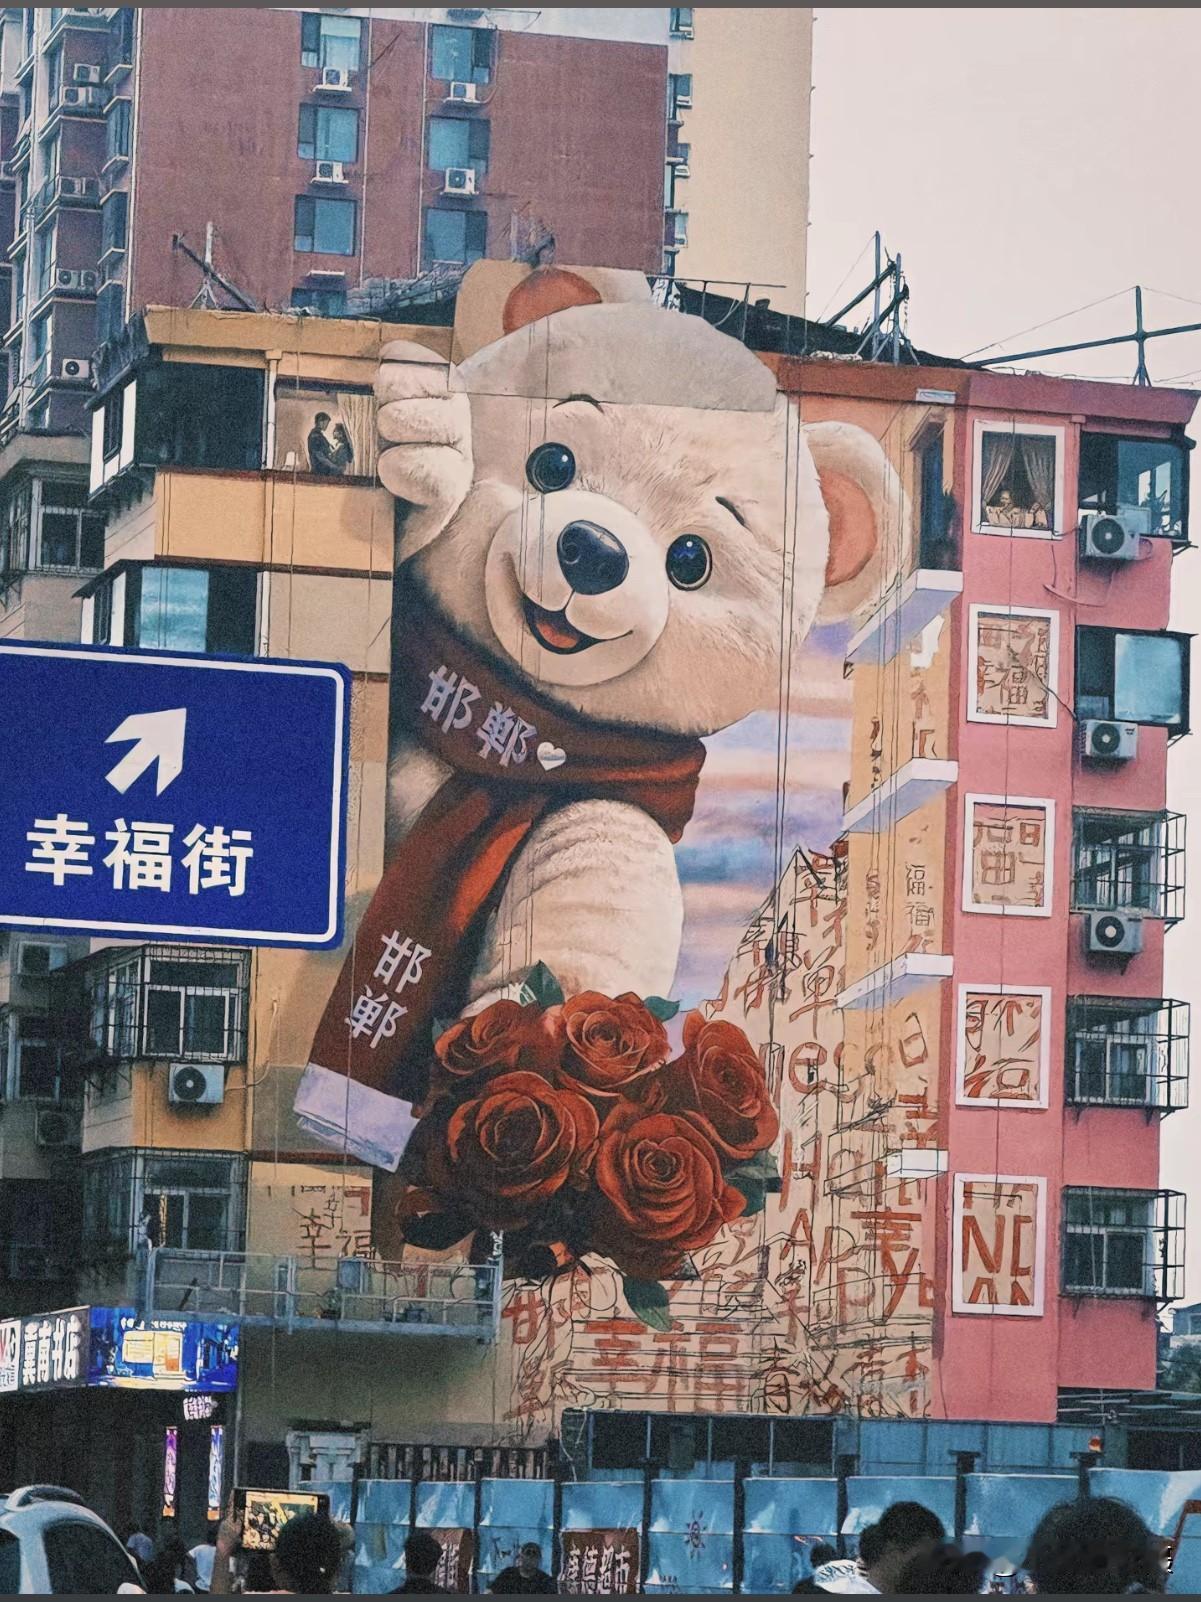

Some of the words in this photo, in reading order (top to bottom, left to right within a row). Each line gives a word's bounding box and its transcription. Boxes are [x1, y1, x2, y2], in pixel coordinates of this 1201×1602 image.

[420, 664, 537, 767] 邯郸
[25, 814, 254, 896] 幸福街
[345, 930, 431, 1049] 邯郸
